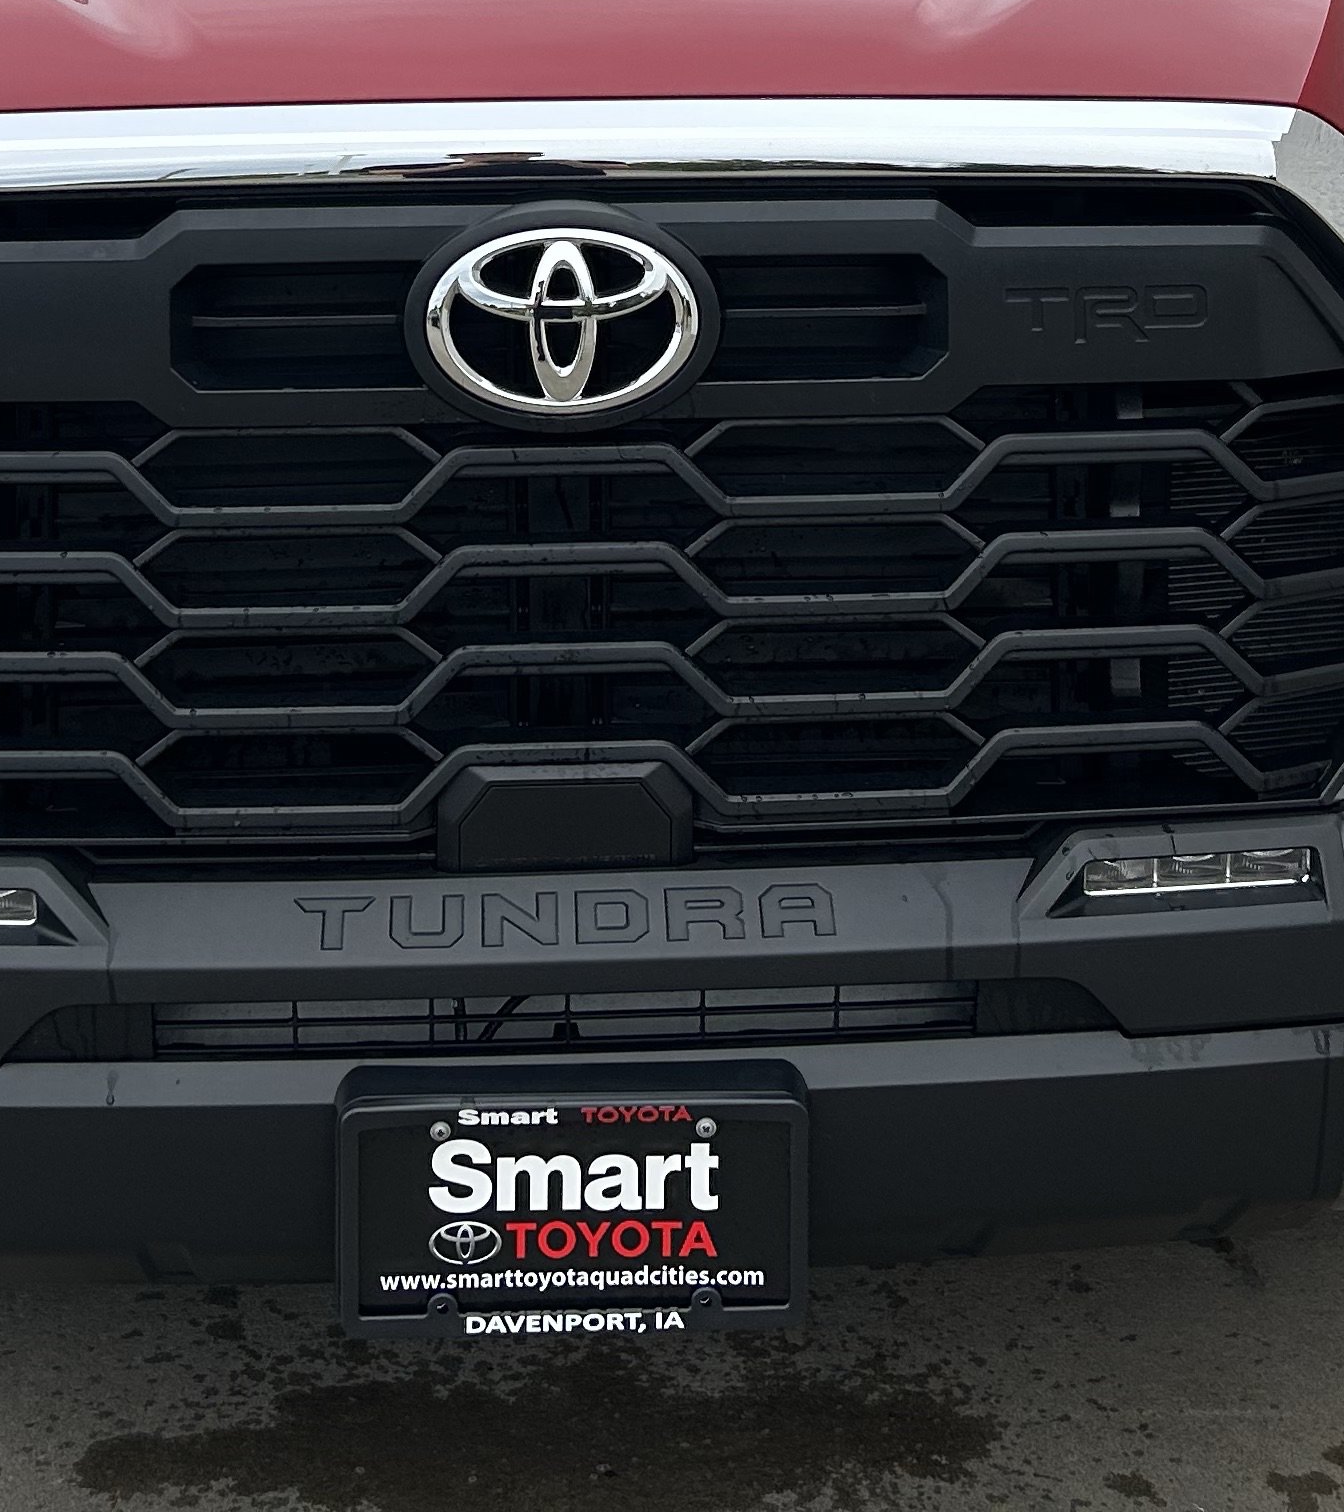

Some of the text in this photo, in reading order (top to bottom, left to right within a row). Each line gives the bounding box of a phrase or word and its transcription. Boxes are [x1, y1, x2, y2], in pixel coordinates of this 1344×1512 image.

[1005, 284, 1208, 344] TRD
[293, 883, 837, 950] TUNDRA
[458, 1104, 693, 1126] Smart TOYOTA
[428, 1138, 720, 1213] Smart
[506, 1220, 718, 1259] TOYOTA
[380, 1265, 765, 1291] www.smarttoyotaquadcities.com
[465, 1311, 684, 1334] DAVENPORT, IA
